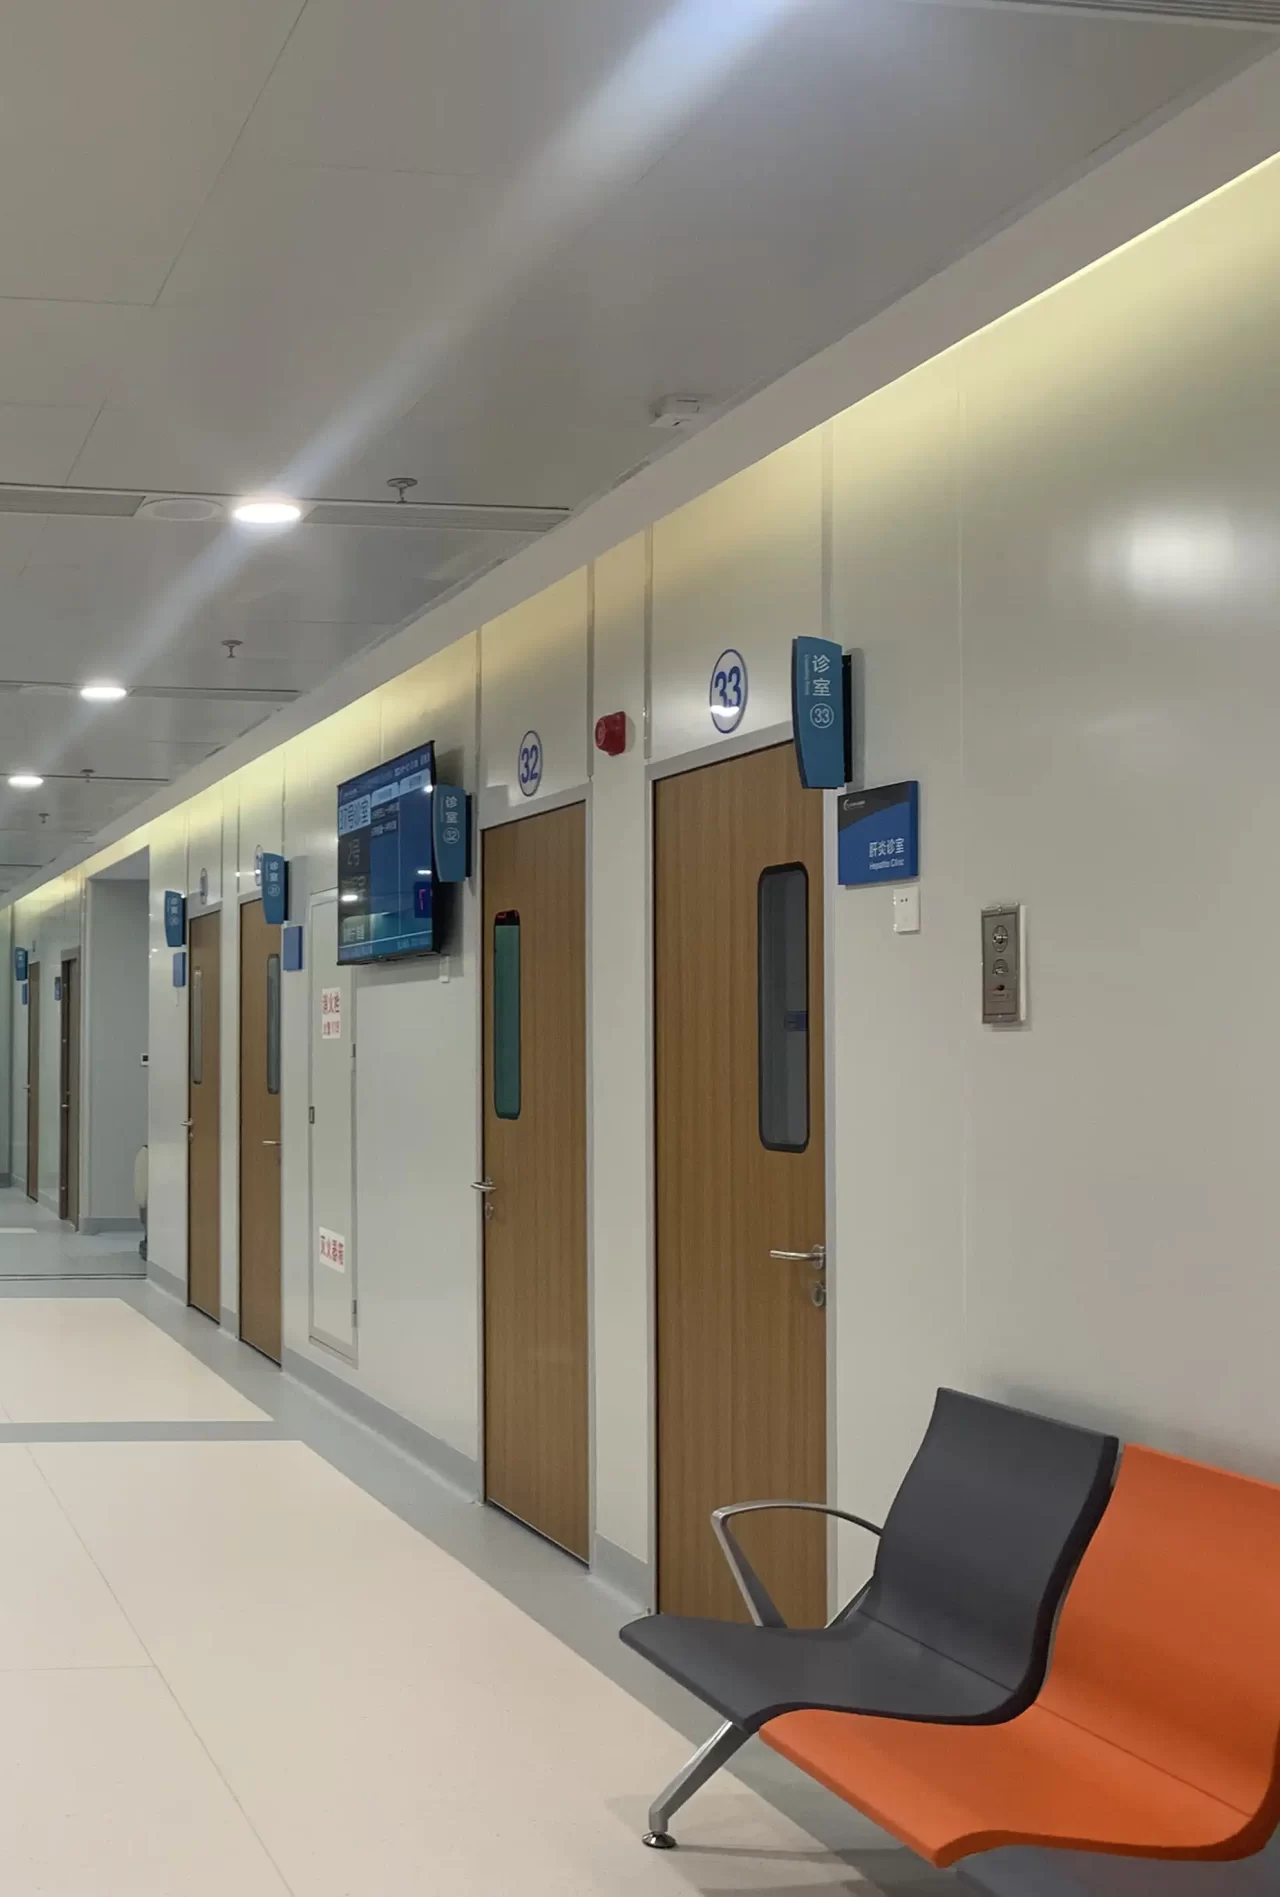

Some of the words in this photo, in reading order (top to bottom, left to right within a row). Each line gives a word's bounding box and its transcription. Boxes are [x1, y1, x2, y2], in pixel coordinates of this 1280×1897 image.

[715, 666, 741, 708] 33
[812, 654, 831, 696] 诊室
[814, 708, 830, 724] 33
[521, 745, 539, 784] 32
[869, 837, 905, 858] 肝炎诊室
